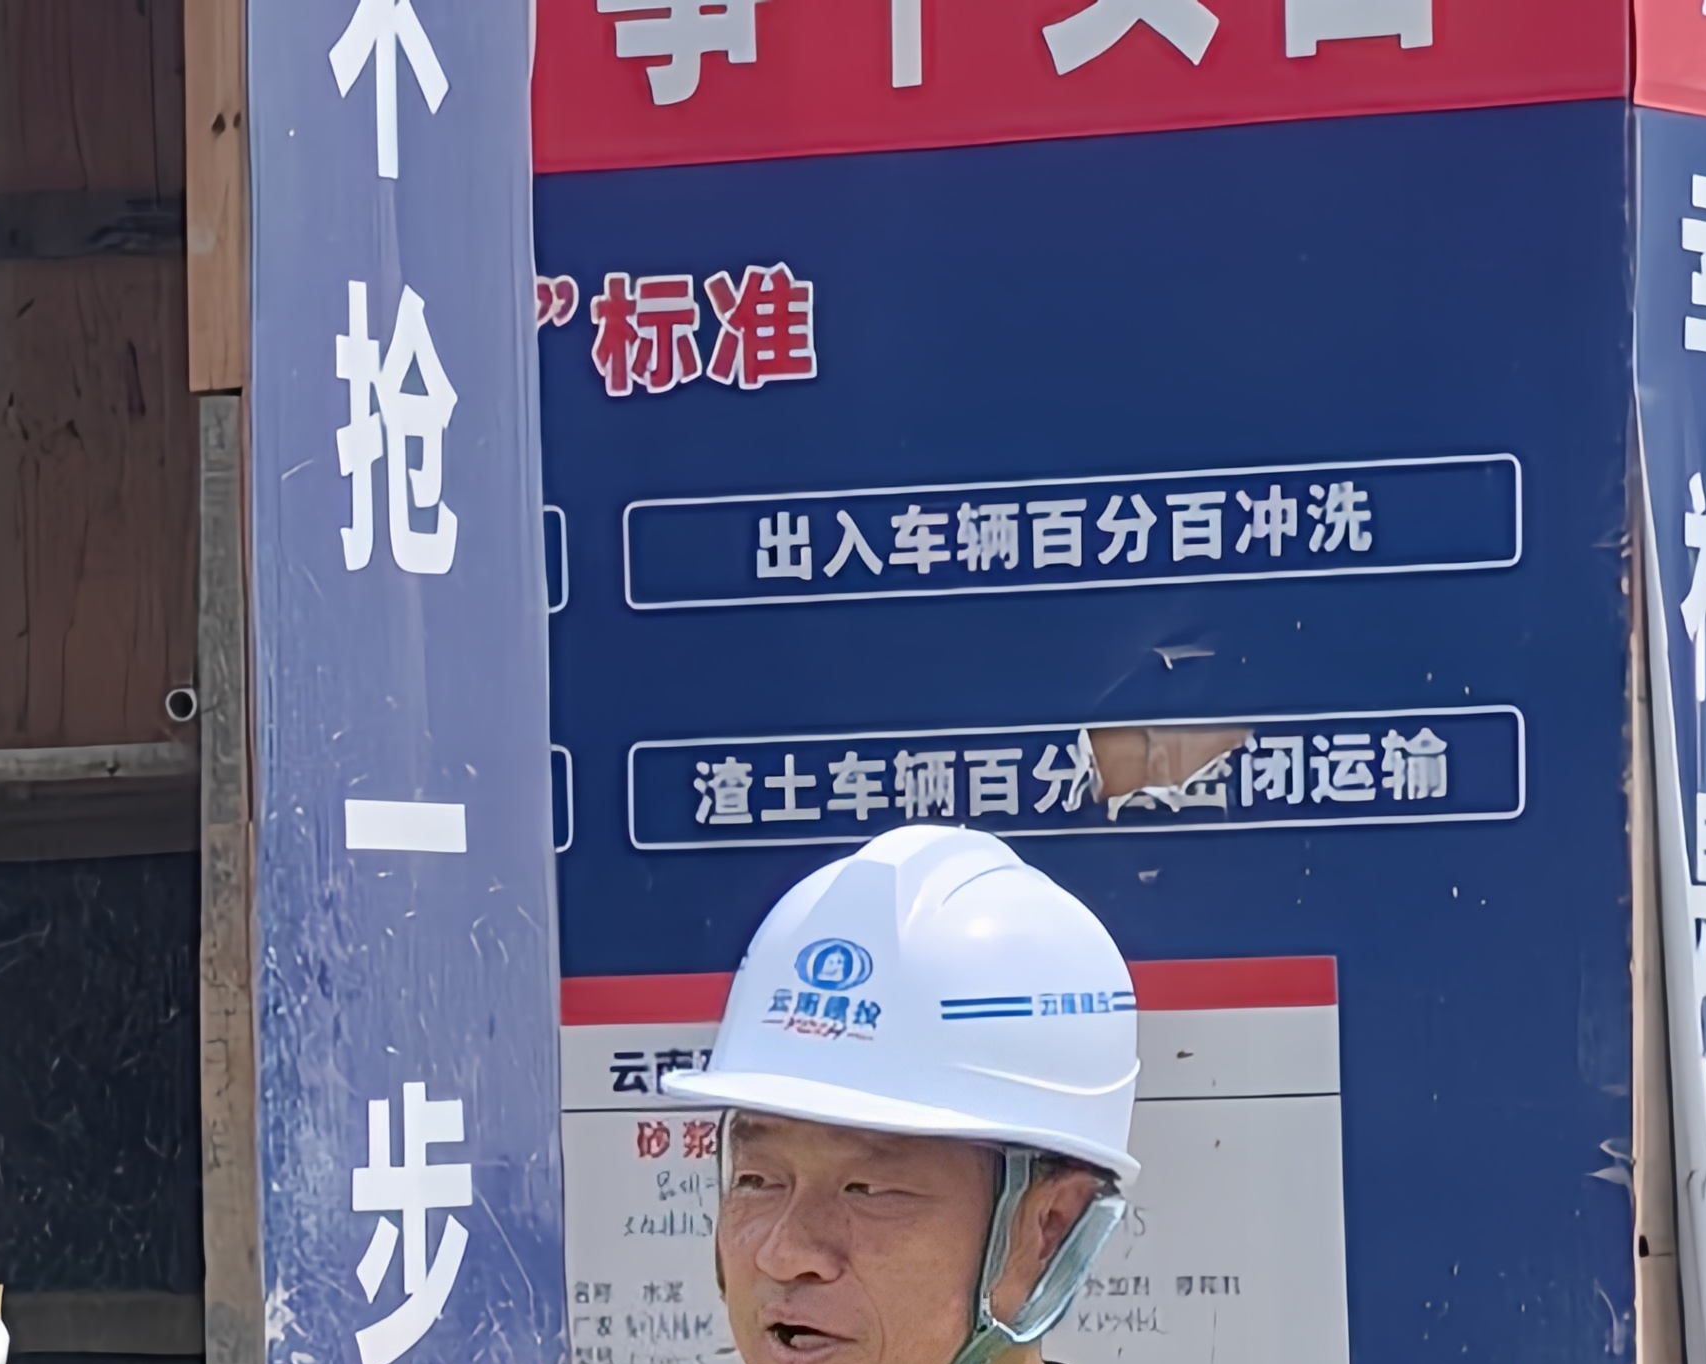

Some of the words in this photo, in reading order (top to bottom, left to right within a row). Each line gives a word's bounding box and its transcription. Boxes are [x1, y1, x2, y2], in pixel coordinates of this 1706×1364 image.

[756, 481, 1374, 582] 出入车辆百分百冲洗
[693, 728, 1449, 826] 渣土车辆百分闭运输
